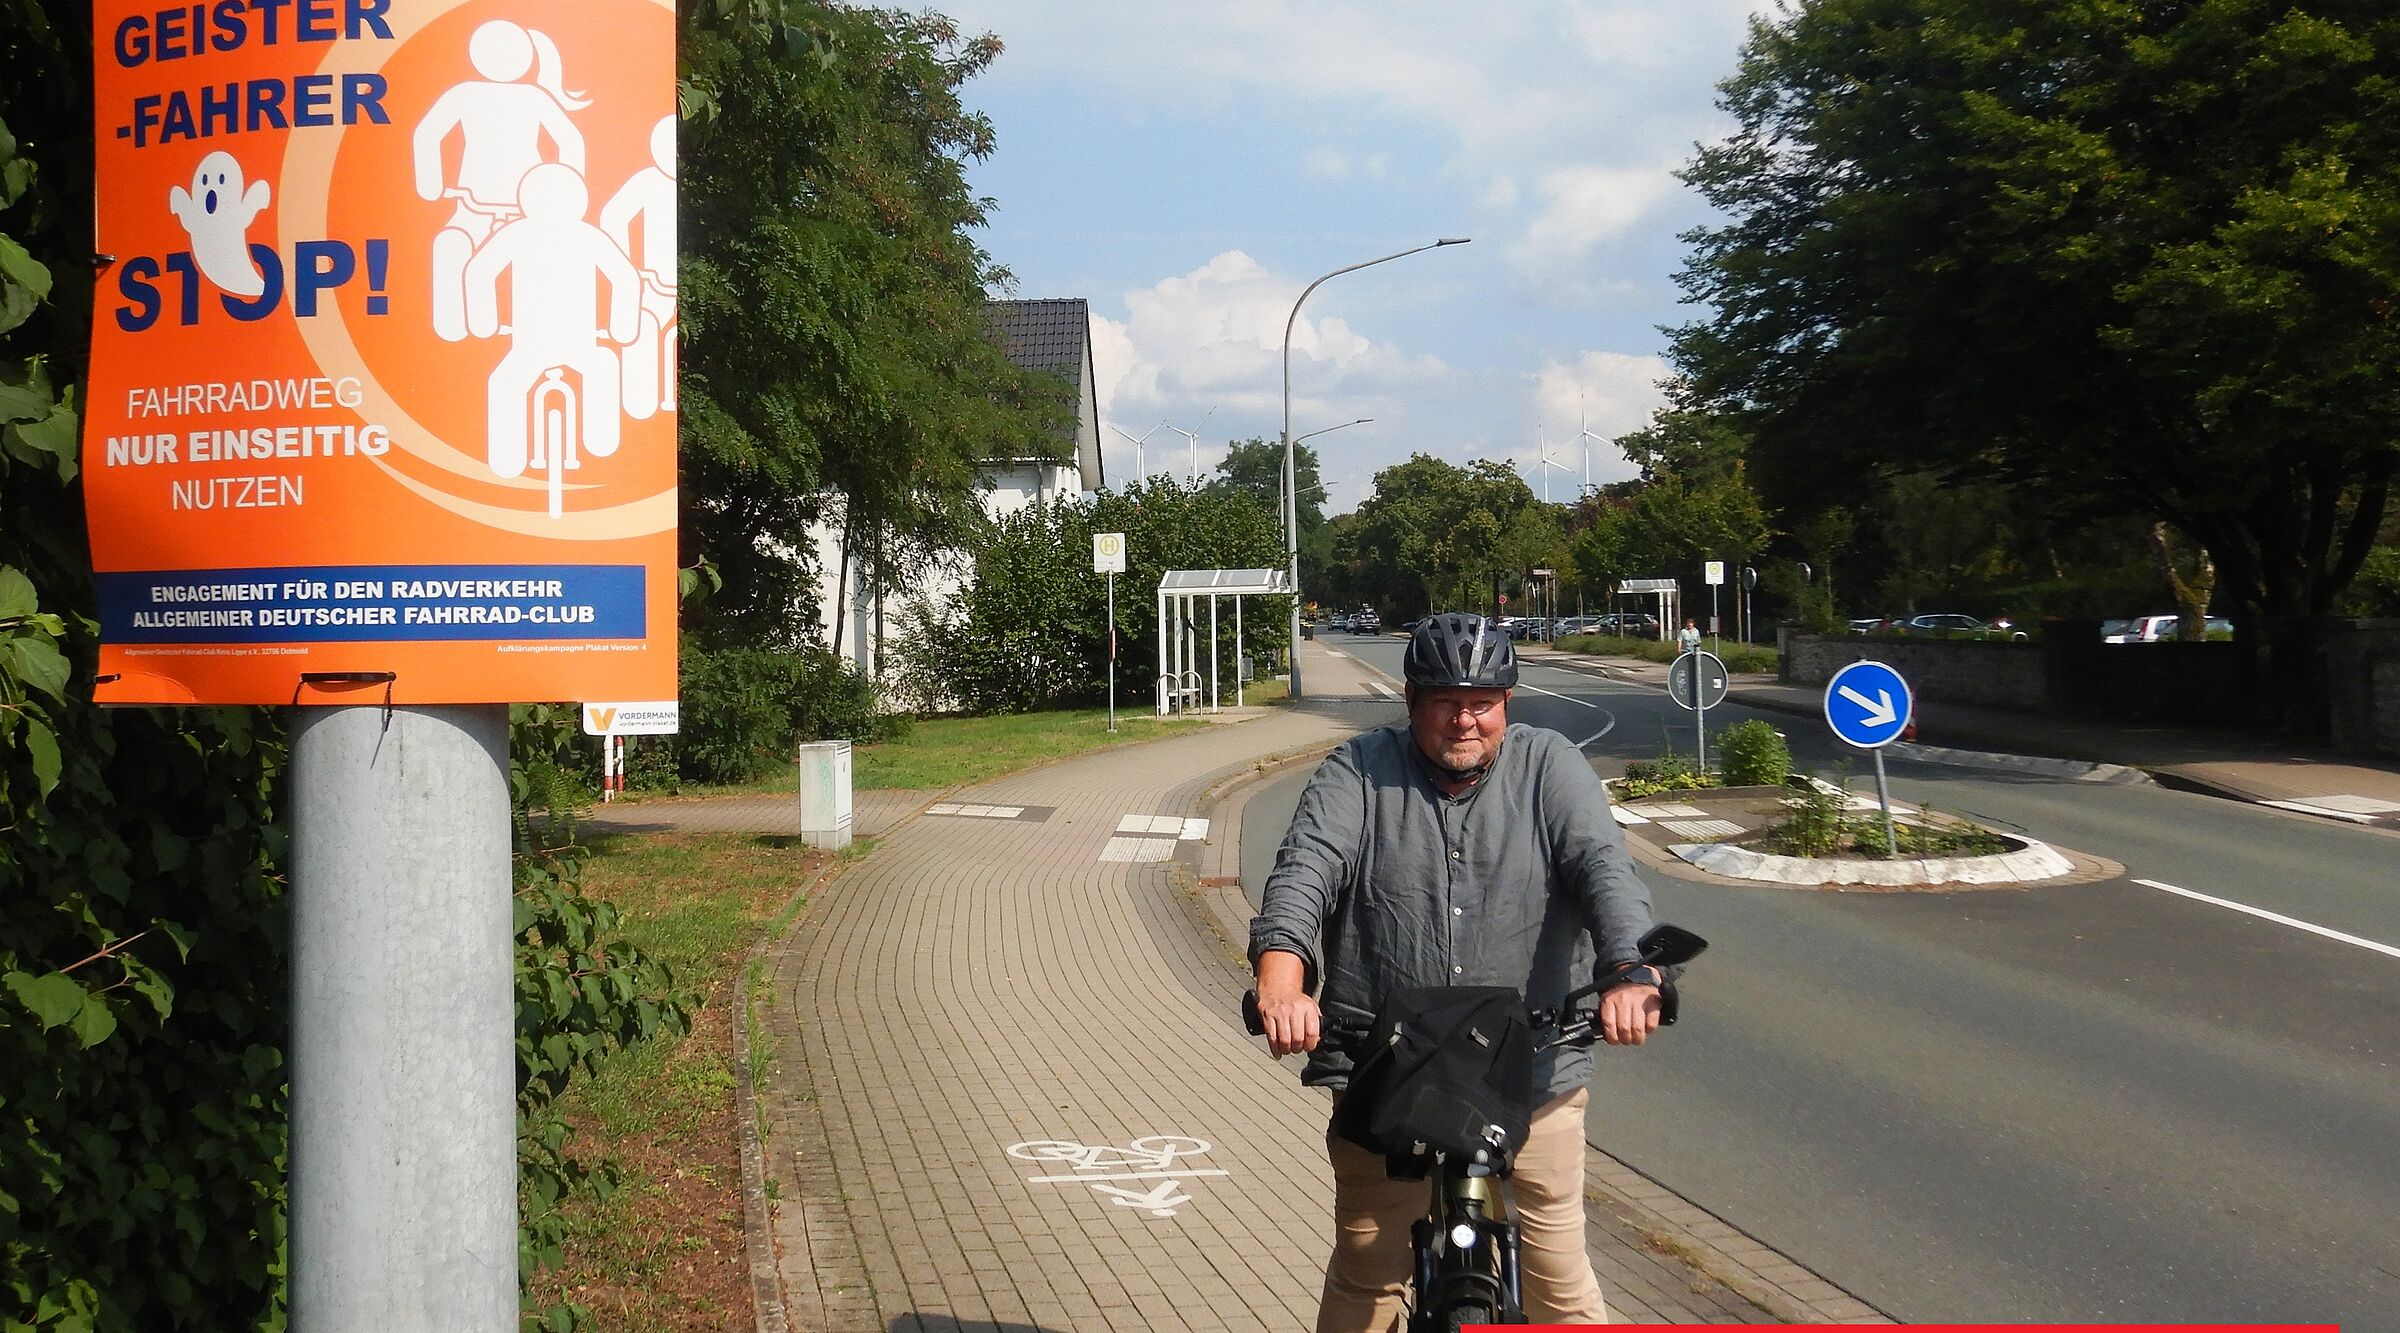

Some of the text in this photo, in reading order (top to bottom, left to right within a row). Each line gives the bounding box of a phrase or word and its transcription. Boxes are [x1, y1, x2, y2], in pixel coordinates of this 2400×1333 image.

[114, 0, 395, 68] GEISTER
[116, 73, 391, 148] -FAHRER
[115, 238, 389, 332] STOP!
[127, 376, 363, 419] FAHRRADWEG
[106, 425, 390, 467] NUR EINSEITIG
[172, 475, 303, 510] NUTZEN
[1104, 540, 1115, 551] H
[151, 579, 563, 603] ENGAGEMENT FÜR DEN RADVERKEHR
[133, 606, 595, 628] ALLGEMEINER DEUTSCHER FAHRRAD-CLUB
[497, 643, 647, 653] Aufklärungskampagne Plakat Version 4
[618, 712, 677, 720] VORDERMANN
